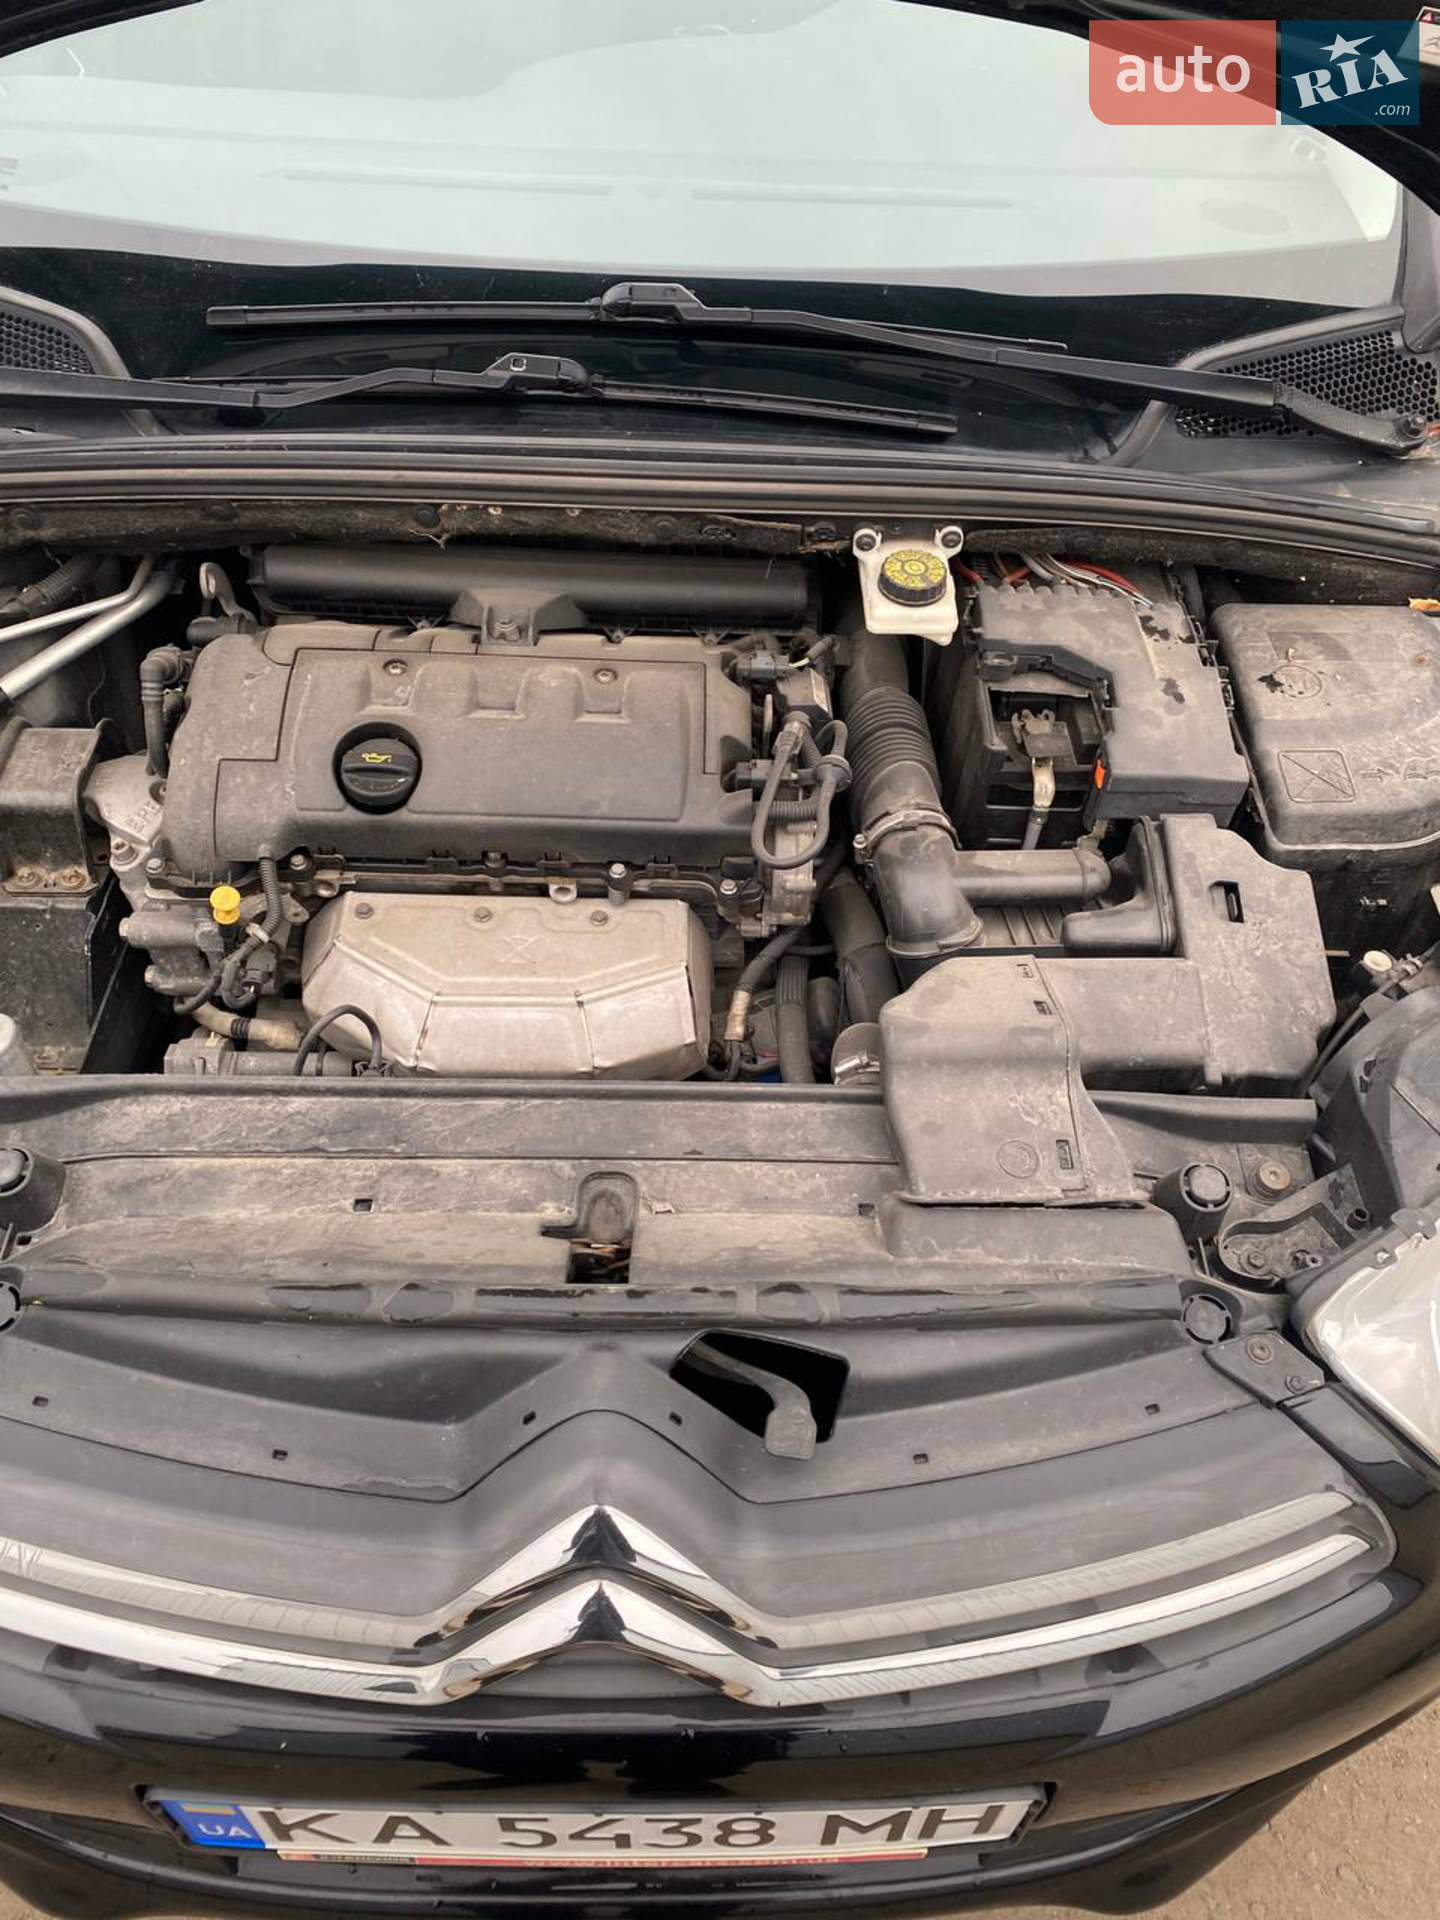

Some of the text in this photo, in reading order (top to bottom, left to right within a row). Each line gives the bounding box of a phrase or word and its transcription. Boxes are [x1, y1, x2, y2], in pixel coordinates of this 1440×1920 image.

[199, 1824, 252, 1838] UA
[259, 1805, 1005, 1848] KA 5438 MH
